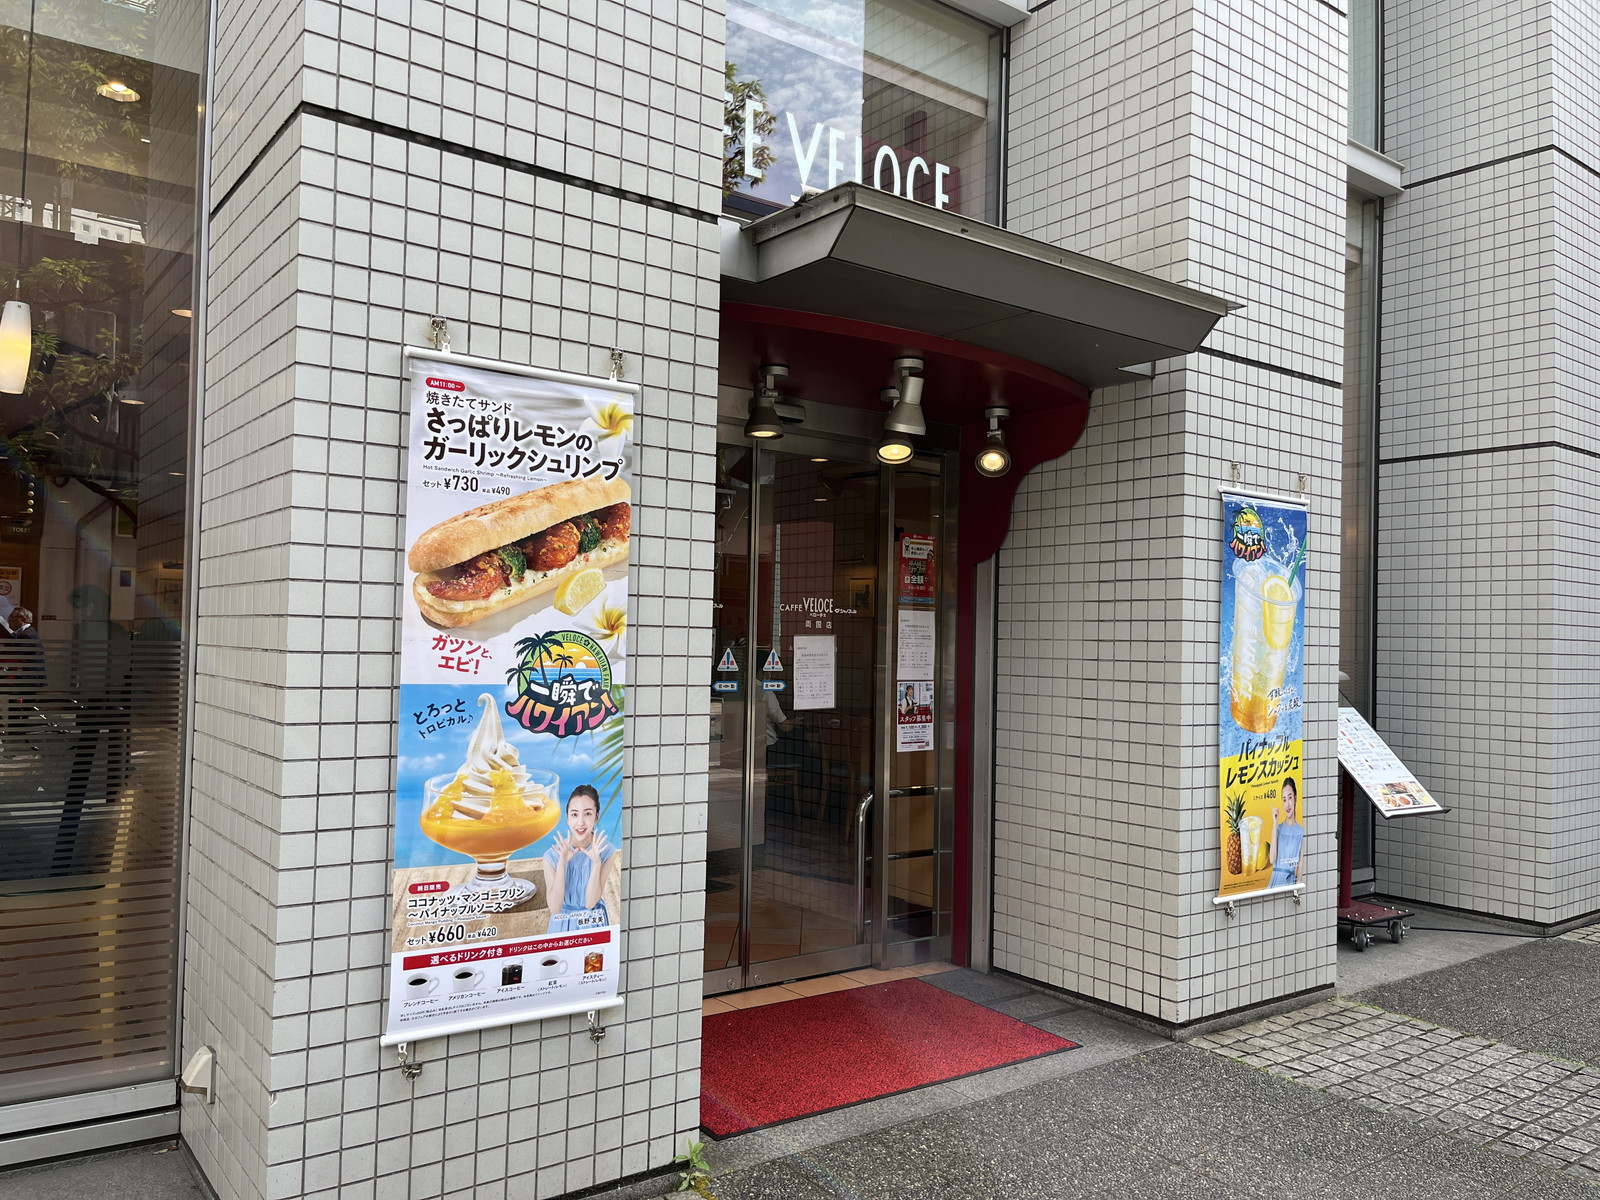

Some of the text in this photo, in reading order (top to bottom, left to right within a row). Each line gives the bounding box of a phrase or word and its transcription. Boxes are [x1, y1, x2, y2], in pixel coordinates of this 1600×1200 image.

[723, 91, 763, 178] E
[426, 391, 512, 415] 焼きたてサンド
[427, 407, 593, 452] さっぱりレモンの
[423, 436, 623, 481] ガーリックシュリンプ
[422, 480, 442, 488] セット
[444, 475, 479, 492] ¥730
[492, 486, 510, 495] ¥490
[803, 597, 833, 613] VELOCE
[432, 634, 492, 660] ガツンと、
[562, 633, 584, 644] VELOCE
[589, 644, 607, 672] HAWAIIAN
[438, 654, 480, 675] エビ!
[530, 676, 598, 705] 一瞬で
[413, 698, 466, 726] とろっと
[508, 692, 617, 735] ハワイアン!
[1238, 733, 1290, 762] パイナップル
[1225, 755, 1299, 789] レモンスカッシュ
[408, 888, 525, 908] ココナッツ・マンゴープリン
[407, 936, 426, 946] セット
[429, 924, 465, 943] ¥660
[478, 927, 497, 936] ¥420
[430, 936, 593, 965] 選べるドリンク付き ドリンクはこの中からお選びください
[403, 999, 439, 1008] ブレンドコーヒー
[448, 992, 485, 1001] アメリカンコーヒー
[496, 986, 525, 994] アイスコーヒー
